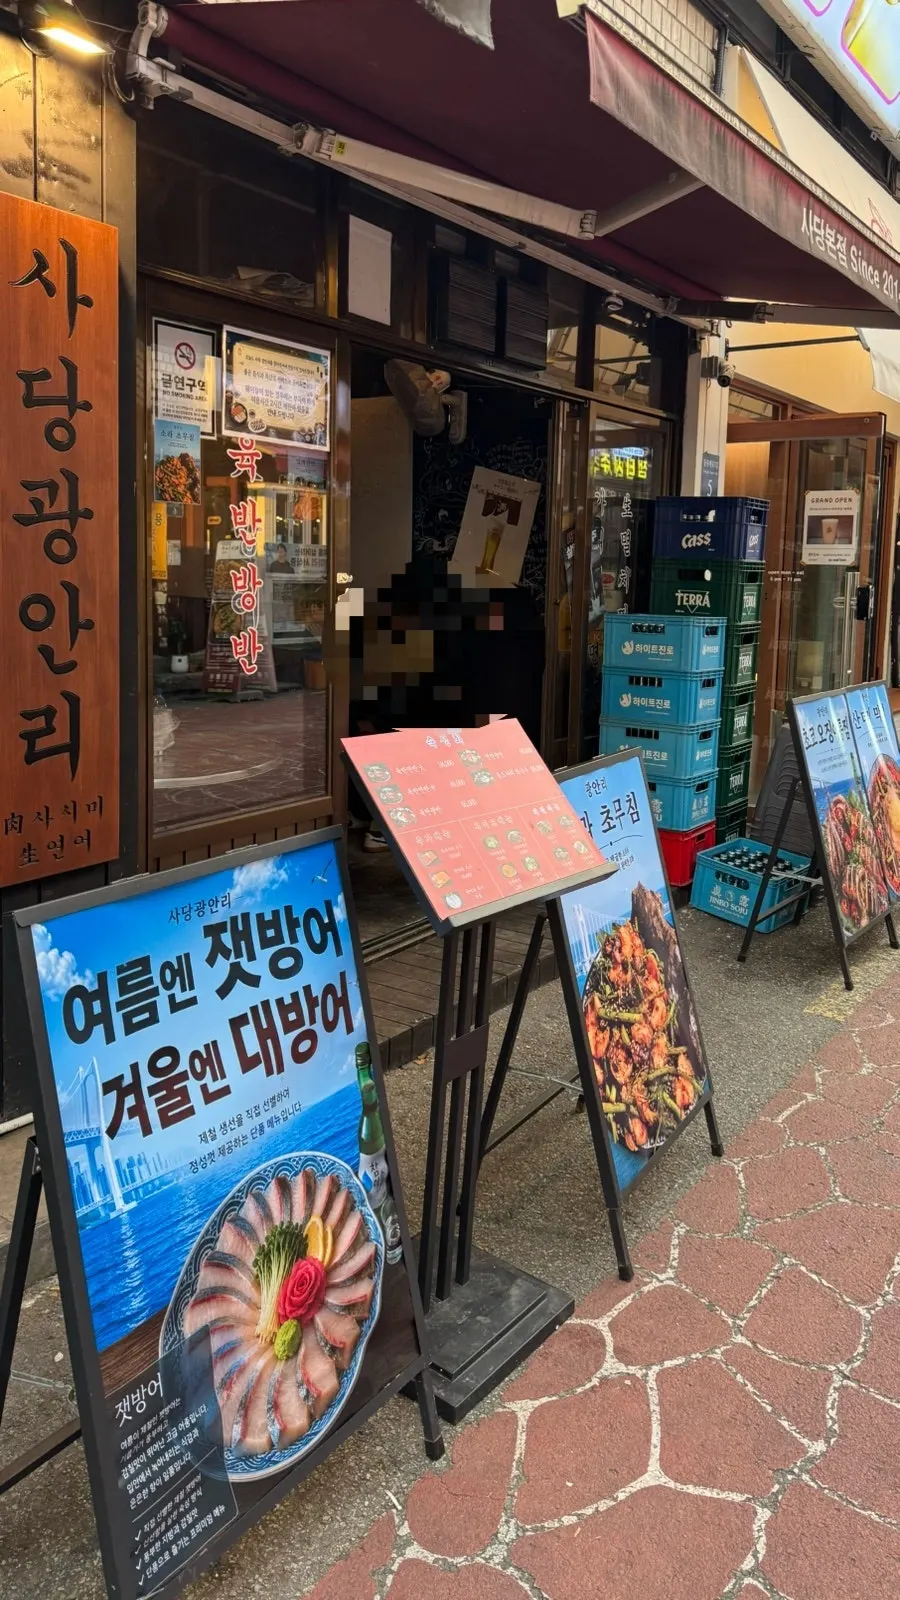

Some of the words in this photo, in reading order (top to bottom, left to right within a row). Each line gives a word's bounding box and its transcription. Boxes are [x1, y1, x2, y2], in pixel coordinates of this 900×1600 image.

[801, 207, 848, 269] 사당본점
[850, 245, 880, 289] Since
[882, 270, 900, 303] 201
[172, 392, 194, 400] SMOKING
[8, 237, 95, 783] 사당광안리
[227, 437, 264, 675] 육반방반
[675, 590, 711, 608] TERRA
[743, 594, 756, 609] TERRA
[635, 643, 674, 655] 하이트진로
[738, 654, 752, 670] TERRA
[632, 697, 671, 709] 하이트진로
[734, 714, 747, 730] TERRA
[642, 749, 668, 761] 트진로
[585, 776, 607, 798] 광안리
[729, 772, 743, 788] TERRA
[600, 791, 640, 834] 초무침
[167, 893, 232, 923] 사당광안리
[709, 896, 729, 909] JINRO
[731, 902, 748, 915] SOJU
[62, 953, 199, 1045] 여름엔
[203, 899, 344, 1000] 잿방어
[102, 1038, 232, 1141] 겨울엔
[228, 971, 355, 1078] 대방어
[198, 1126, 218, 1144] 제철
[219, 1113, 244, 1136] 생선을
[245, 1104, 261, 1120] 직접
[262, 1087, 290, 1112] 선별하여
[188, 1151, 216, 1174] 정성껏
[218, 1134, 248, 1157] 제공하는
[250, 1125, 265, 1140] 단품
[267, 1101, 302, 1129] 메뉴입니다
[115, 1372, 163, 1428] 잿방어
[120, 1430, 140, 1450] 여름이
[140, 1414, 158, 1435] 제철인
[121, 1452, 147, 1480] 감칠맛이
[147, 1437, 165, 1458] 뛰어난
[166, 1428, 178, 1443] 고급
[127, 1467, 152, 1495] 입안에서
[151, 1444, 181, 1471] 녹아내리는
[181, 1428, 199, 1447] 식감과
[129, 1488, 149, 1510] 은은한
[149, 1476, 163, 1493] 향이
[144, 1517, 156, 1532] 직접
[157, 1501, 173, 1522] 선별한
[174, 1489, 185, 1503] 제철
[144, 1540, 161, 1563] 풍부한
[162, 1524, 180, 1544] 지방과
[180, 1507, 199, 1530] 감칠맛
[145, 1550, 171, 1579] 단품으로
[171, 1536, 190, 1556] 즐기는
[190, 1512, 214, 1540] 프리미엄
[213, 1504, 226, 1518] 메뉴
